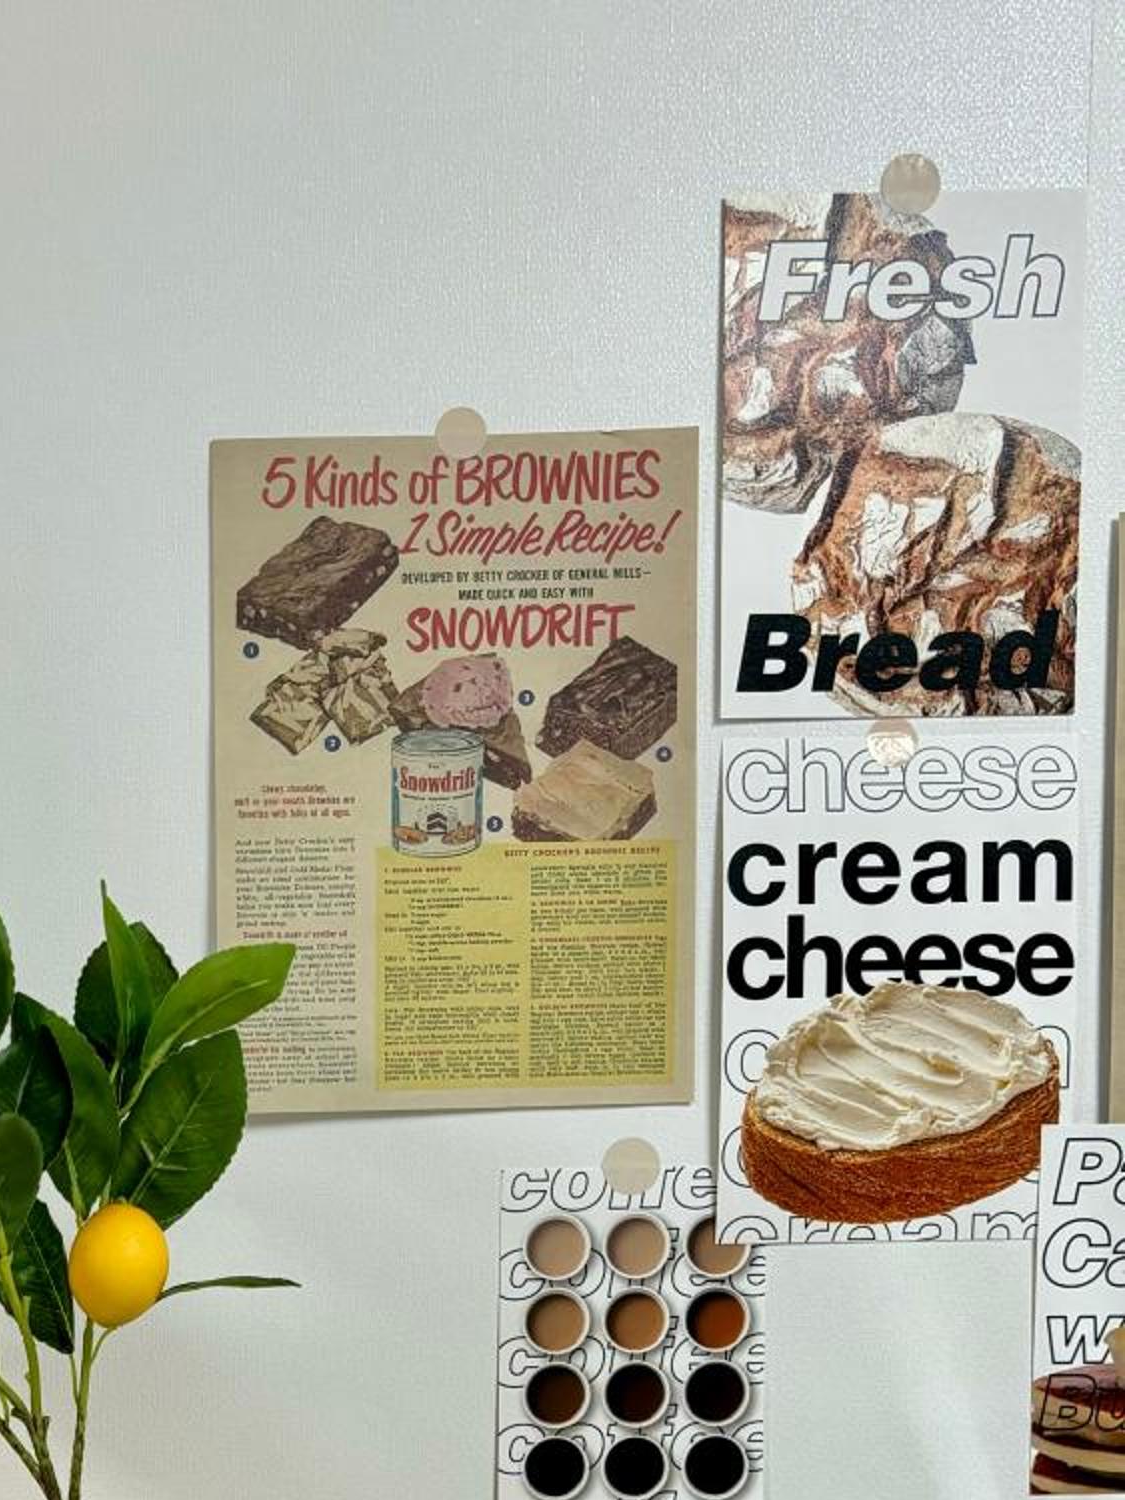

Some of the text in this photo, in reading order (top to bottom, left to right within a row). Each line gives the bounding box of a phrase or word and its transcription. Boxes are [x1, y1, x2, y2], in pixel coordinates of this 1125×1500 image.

[758, 233, 1066, 322] Fresh
[261, 450, 661, 509] 5 Kinds of BROWNIES
[399, 509, 682, 565] 1 Simple Recipe!
[402, 570, 454, 585] DEVELOPED
[456, 569, 470, 584] BY
[472, 569, 503, 583] BETTY
[506, 568, 549, 583] CROCKER
[553, 567, 565, 581] OF
[568, 567, 609, 581] GENERAL
[458, 585, 594, 601] MADE QUICK AND EASY WITH
[406, 602, 636, 653] SNOWDRIFT
[736, 606, 1060, 694] Bread
[400, 766, 475, 793] Snowdrift
[725, 737, 1077, 814] cheese
[727, 838, 1072, 906] cream
[727, 913, 1074, 999] cheese
